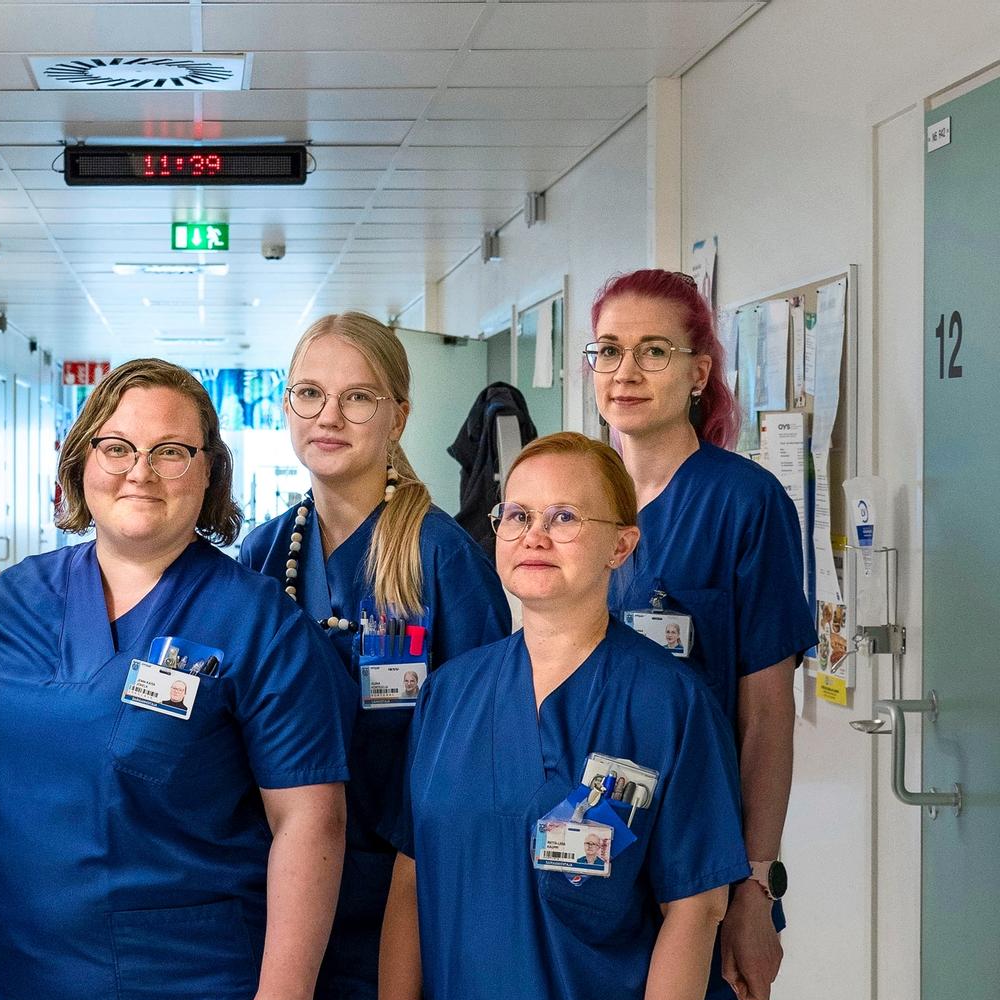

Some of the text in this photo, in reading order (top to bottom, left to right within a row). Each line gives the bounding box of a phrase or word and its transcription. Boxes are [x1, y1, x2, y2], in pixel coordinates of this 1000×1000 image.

[144, 155, 220, 175] 11:39
[935, 310, 963, 379] 12
[777, 423, 791, 431] OYS
